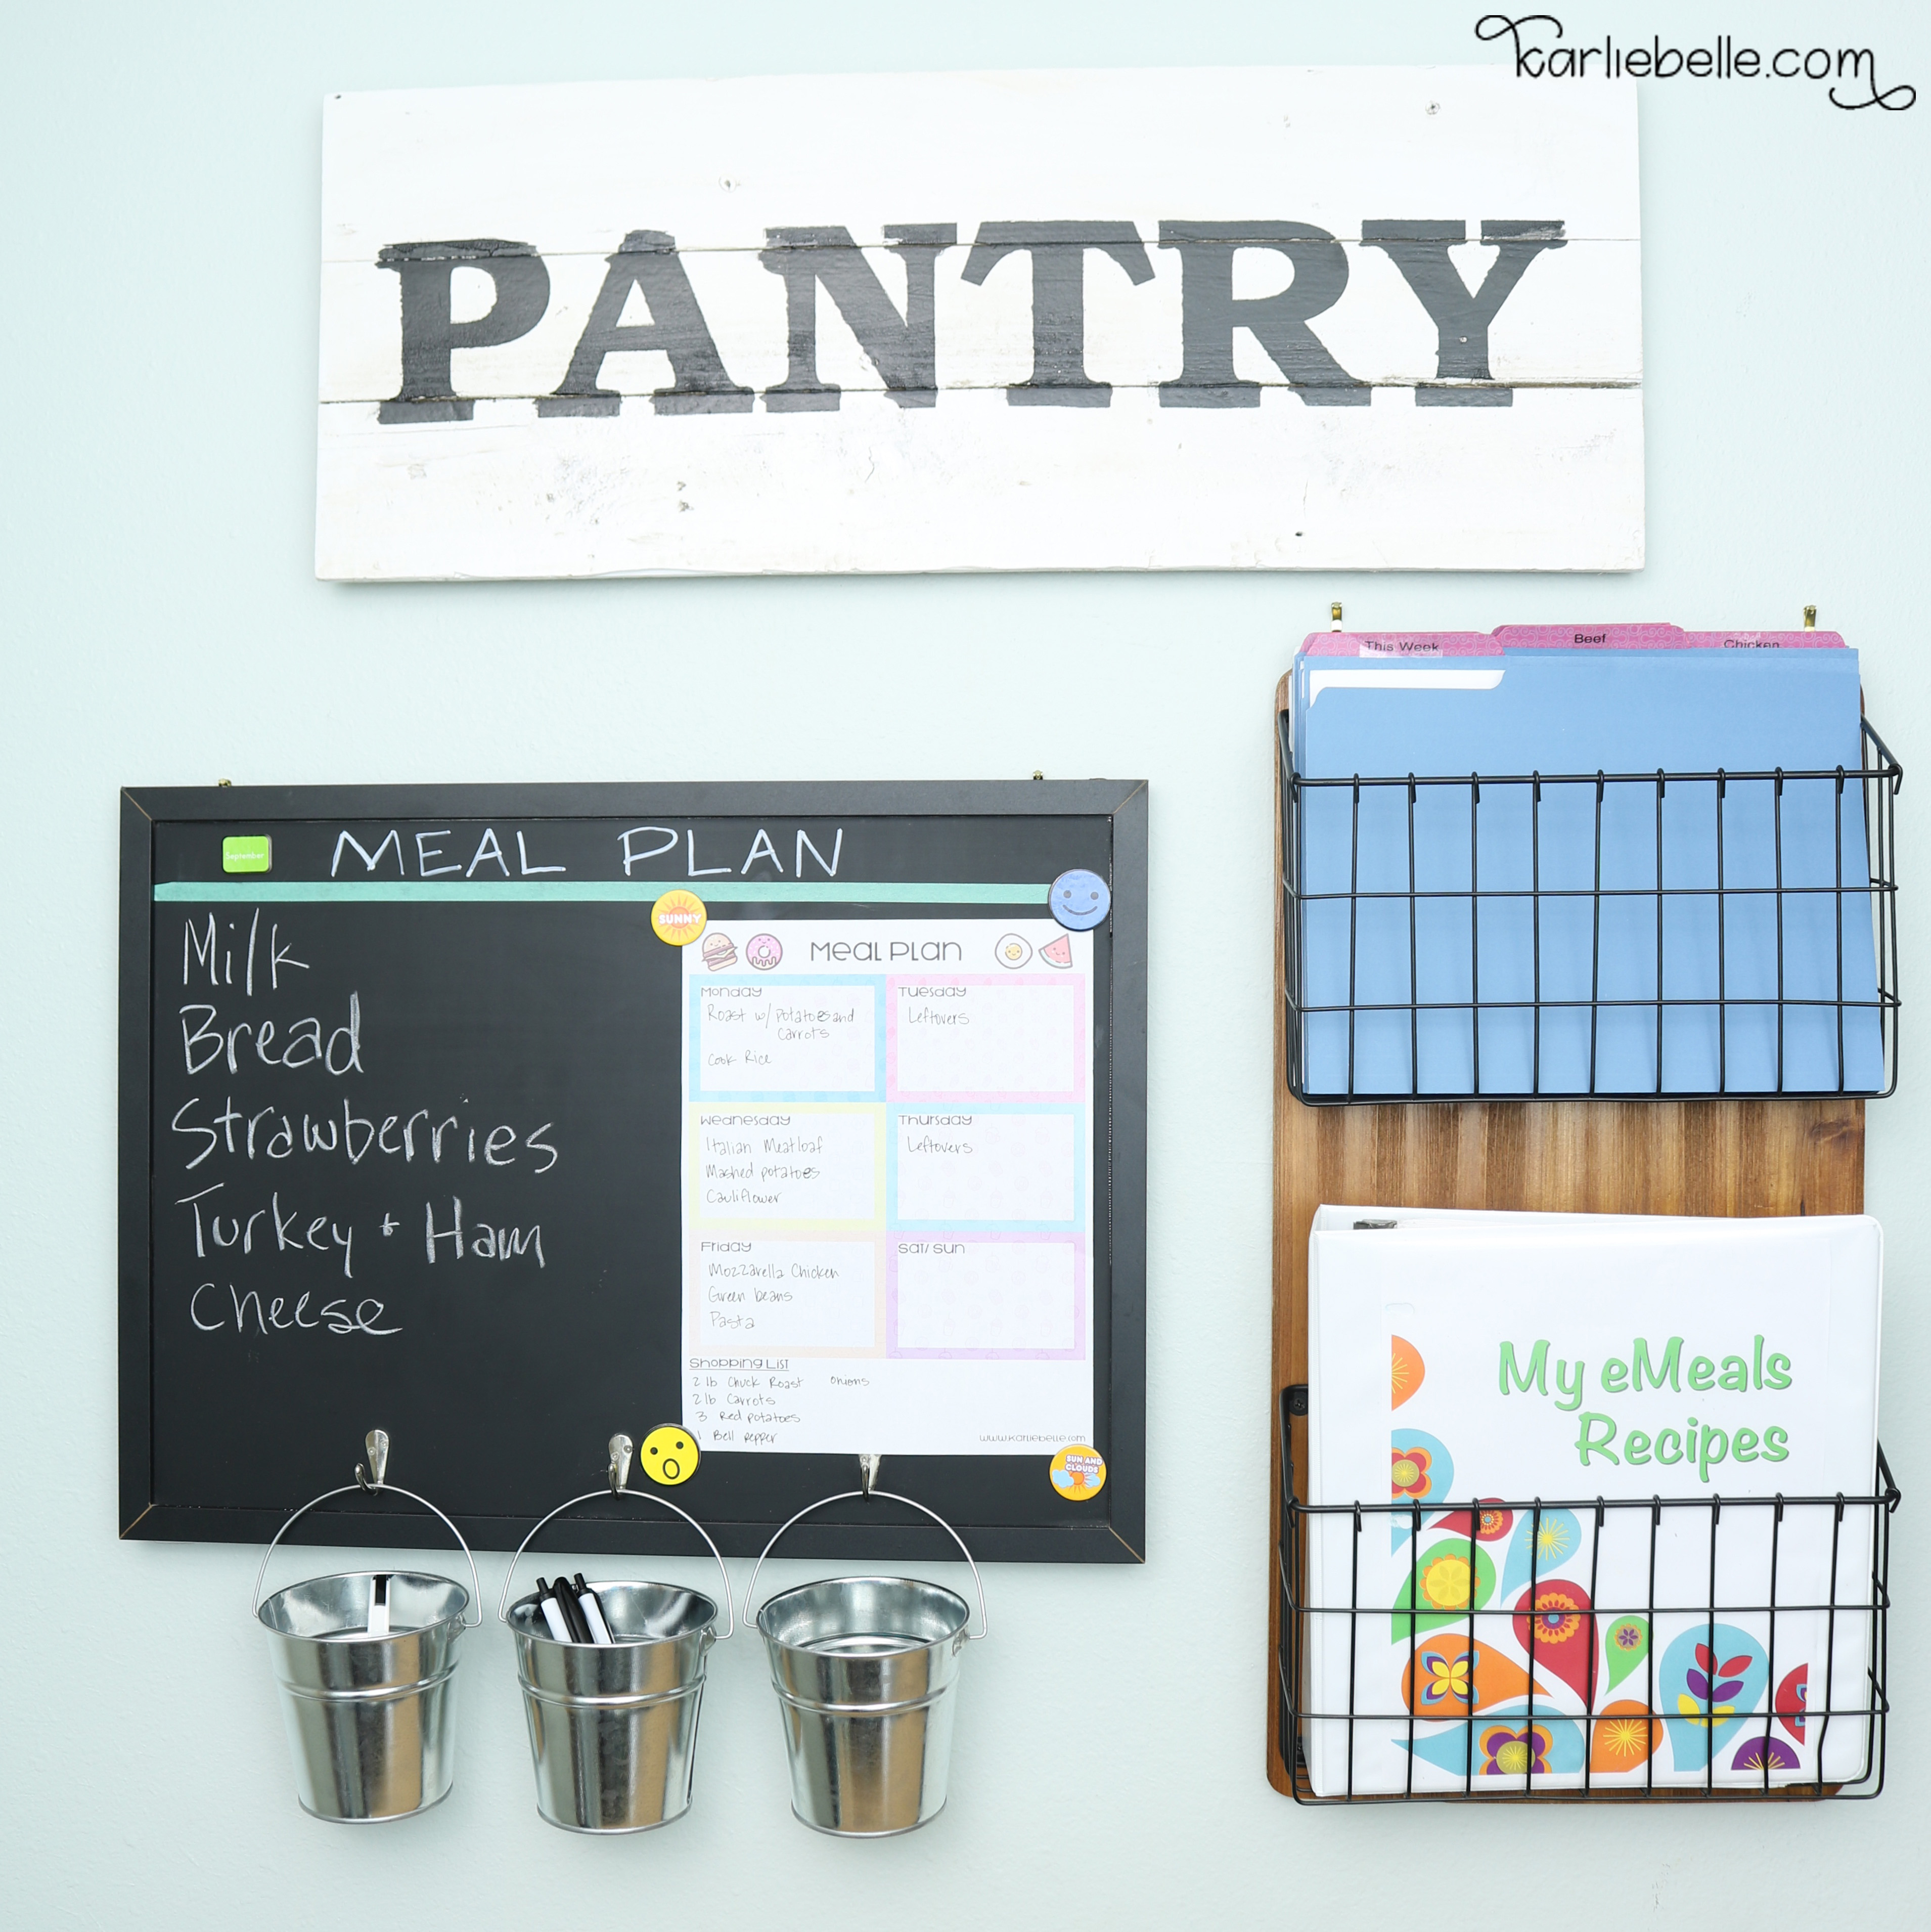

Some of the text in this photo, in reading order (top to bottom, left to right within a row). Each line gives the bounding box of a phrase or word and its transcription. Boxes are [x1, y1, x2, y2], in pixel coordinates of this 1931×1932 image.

[376, 218, 1566, 424] PANTRY
[1365, 641, 1439, 652] This Week
[1575, 634, 1606, 643] Beef
[1724, 639, 1780, 648] Chicken
[226, 851, 264, 862] September
[331, 826, 843, 879] MEAL PLAN
[659, 913, 702, 925] SUNNY
[184, 907, 309, 996] Milk
[701, 987, 762, 997] Monday
[897, 987, 967, 997] Tuesday
[707, 1003, 746, 1022] Roast
[755, 1002, 771, 1029] w/
[832, 1007, 854, 1023] and
[909, 1006, 970, 1025] Leftovers
[179, 988, 364, 1076] Bread
[708, 1049, 772, 1066] Cook Rice
[700, 1115, 791, 1126] Wednesday
[897, 1115, 972, 1126] Thursday
[171, 1096, 558, 1174] Strawberries
[706, 1135, 823, 1156] Italian Meatloaf
[907, 1135, 973, 1154] Leftovers
[705, 1161, 753, 1180] Mashed
[706, 1188, 782, 1204] Cauliflower
[176, 1182, 353, 1279] Turkey
[426, 1197, 546, 1268] Ham
[701, 1242, 752, 1252] Friday
[708, 1262, 839, 1280] Mozzarella Chicken
[708, 1286, 793, 1303] Green beans
[191, 1283, 403, 1335] Cheese
[709, 1311, 755, 1329] Pasta
[689, 1358, 763, 1369] Shopping
[1499, 1335, 1791, 1411] My eMeals
[692, 1377, 701, 1387] 2
[728, 1375, 760, 1388] Chuck
[769, 1376, 804, 1389] Roast
[692, 1393, 702, 1405] 2
[695, 1411, 707, 1422] 3
[720, 1409, 742, 1421] Red
[713, 1429, 734, 1441] Bell
[1575, 1412, 1788, 1482] Recipes
[1066, 1455, 1102, 1465] SUN AND
[1065, 1464, 1099, 1473] CLOUDS
